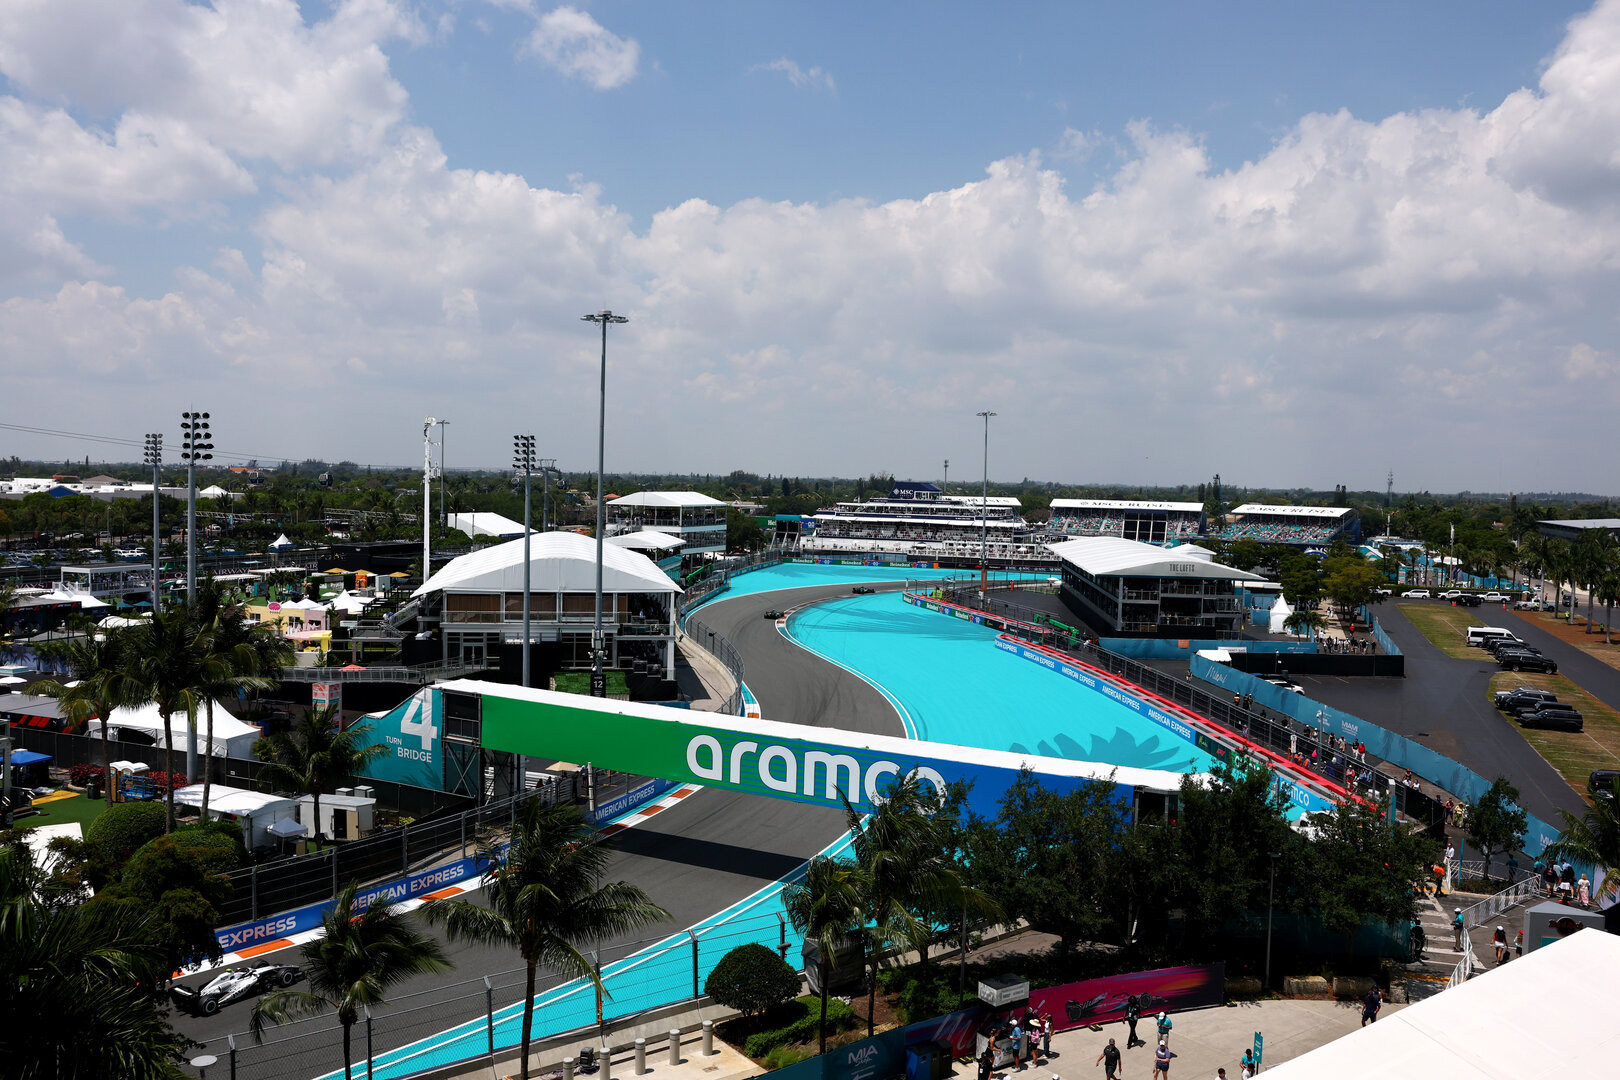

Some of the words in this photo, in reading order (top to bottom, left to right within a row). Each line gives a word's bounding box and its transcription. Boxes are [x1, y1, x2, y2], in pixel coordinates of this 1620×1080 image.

[1023, 650, 1040, 665] AMERICAN
[1038, 655, 1055, 669] EXPRESS
[593, 680, 603, 689] 12
[1061, 665, 1079, 680] AMERICAN
[1078, 673, 1096, 688] EXPRESS
[1102, 684, 1122, 702] AMERICAN
[1121, 694, 1140, 711] EXPRESS
[400, 688, 438, 751] 4
[1148, 708, 1171, 729] AMERICAN
[1170, 721, 1191, 739] EXPRESS
[385, 736, 402, 745] TURN
[397, 747, 432, 763] BRIDGE
[628, 784, 656, 806] EXPRESS
[410, 864, 465, 892] EXPRESS
[218, 915, 297, 949] EXPRESS
